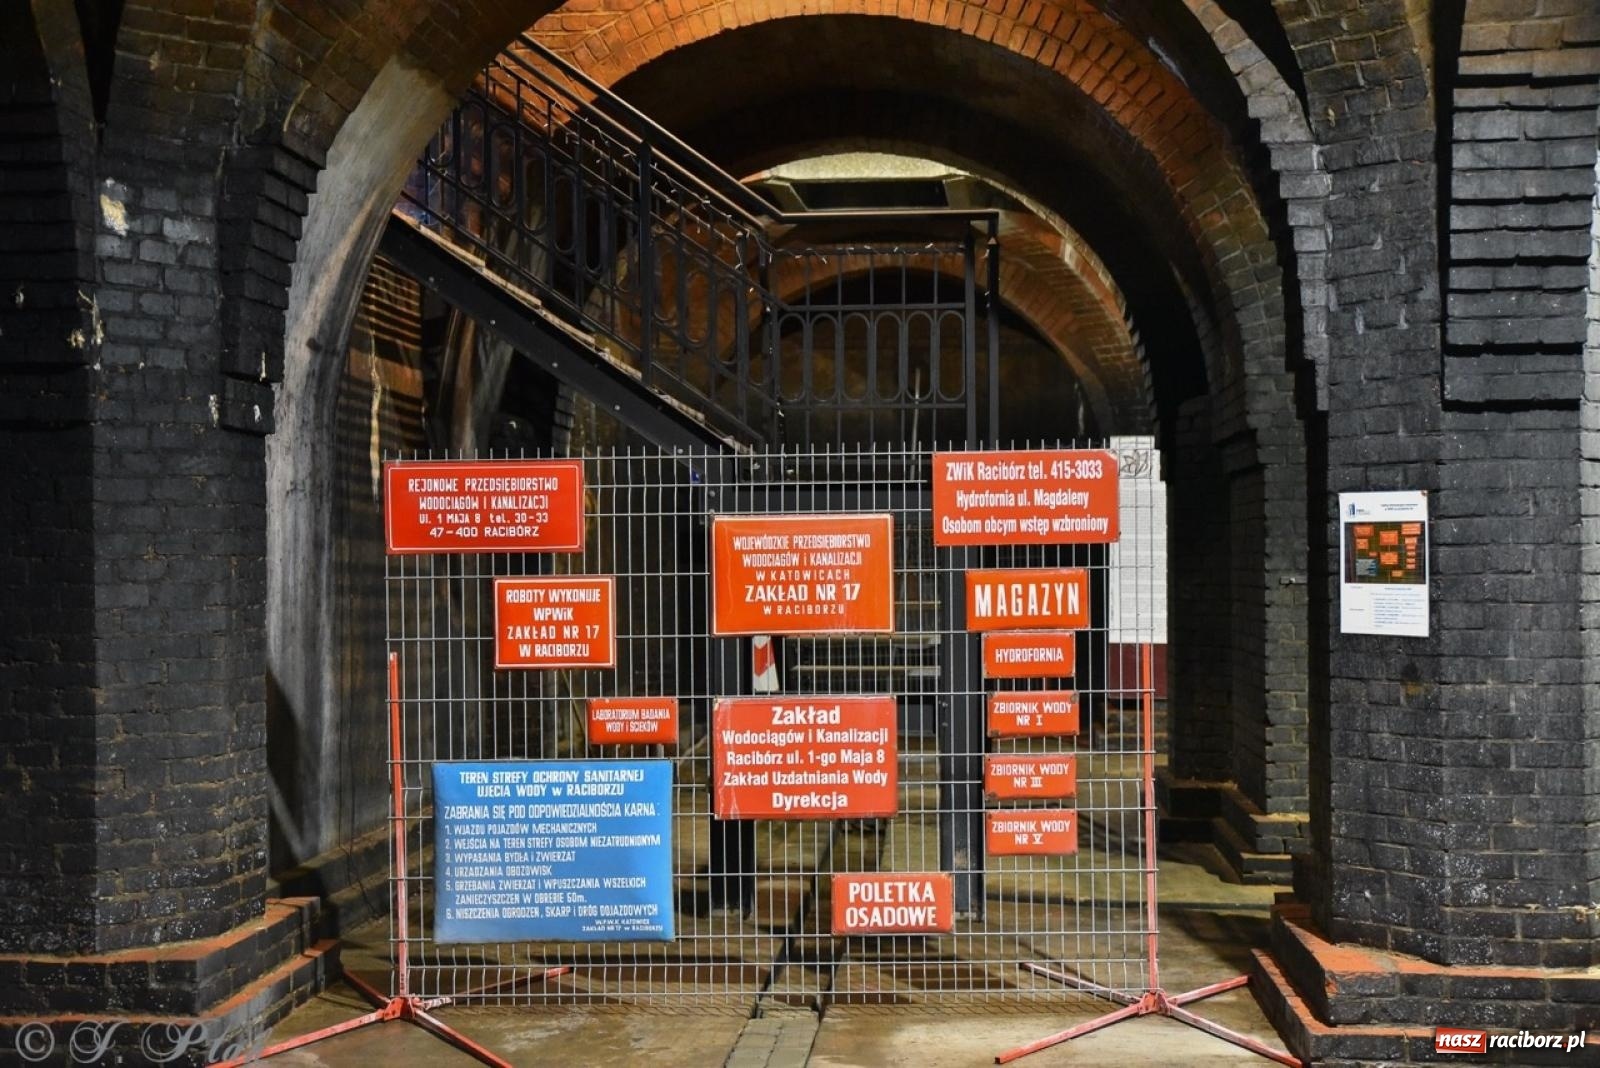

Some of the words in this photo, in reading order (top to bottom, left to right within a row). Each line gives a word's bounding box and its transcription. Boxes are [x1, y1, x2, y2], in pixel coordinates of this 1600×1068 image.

[946, 461, 974, 481] ZWiK
[978, 461, 1025, 480] Racibórz
[1028, 461, 1048, 479] tel.
[1050, 460, 1102, 479] 415-3033
[408, 478, 458, 492] REJONOWE
[465, 477, 558, 493] PRZEDSIĘBIORSTWO
[419, 495, 479, 511] WODOCIĄGÓW
[491, 495, 549, 510] KANALIZACJI
[956, 490, 1014, 511] Hydrofornia
[1018, 490, 1031, 506] ul.
[1033, 488, 1089, 509] Magdaleny
[437, 514, 442, 523] 1
[446, 514, 470, 523] MAJA
[475, 513, 481, 522] 8
[490, 513, 510, 523] tel.
[942, 516, 981, 534] Osobom
[984, 516, 1016, 536] obcym
[1020, 516, 1049, 536] wstęp
[1052, 515, 1109, 534] wzbroniony
[484, 525, 539, 537] RACIBÓRZ
[733, 534, 789, 550] WOJEWÓDZKIE
[793, 533, 871, 551] PRZEDSIĘBIORSTWO
[804, 553, 807, 565] i
[810, 551, 862, 565] KANALIZACJI
[756, 571, 765, 581] W
[771, 569, 850, 581] KATOWICACH
[506, 589, 545, 603] ROBOTY
[548, 588, 601, 603] WYKONUJE
[745, 584, 808, 602] ZAKŁAD
[816, 584, 836, 600] NR
[842, 583, 860, 600] 17
[974, 582, 1080, 617] MAGAZYN
[533, 607, 574, 621] WPWiK
[763, 605, 772, 615] W
[777, 604, 844, 615] RACIBORZU
[507, 625, 556, 640] ZAKŁAD
[563, 625, 579, 639] NR
[585, 625, 600, 639] 17
[519, 644, 531, 657] W
[535, 643, 590, 657] RACIBORZU
[995, 648, 1064, 663] HYDROFORNIA
[592, 708, 639, 720] LABORATORIUM
[641, 708, 670, 719] BADANIA
[771, 705, 841, 725] Zakład
[993, 702, 1039, 714] ZBIORNIK
[1043, 702, 1072, 713] WODY
[1016, 715, 1030, 726] NR
[722, 729, 804, 746] Wodociągów
[808, 729, 812, 743] i
[816, 728, 888, 745] Kanalizacji
[727, 750, 783, 765] Racibórz
[786, 750, 804, 764] ul.
[808, 750, 837, 766] 1-go
[840, 749, 873, 766] Maja
[876, 749, 885, 763] 8
[991, 764, 1035, 775] ZBIORNIK
[1040, 763, 1069, 775] WODY
[459, 771, 488, 785] TEREN
[492, 770, 529, 784] STREFY
[533, 770, 579, 783] OCHRONY
[584, 769, 644, 783] SANITARNEJ
[724, 772, 768, 786] Zakład
[772, 770, 849, 785] Uzdatniania
[852, 769, 888, 786] Wody
[1013, 777, 1027, 788] NR
[1030, 776, 1043, 788] III
[516, 784, 547, 796] WODY
[566, 783, 625, 796] RACIBORZU
[772, 792, 848, 811] Dyrekcja
[444, 805, 490, 820] ZABRANIA
[492, 805, 506, 821] SIĘ
[508, 805, 526, 818] POD
[454, 825, 486, 835] WJAZDU
[532, 822, 597, 834] MECHANICZNYCH
[992, 820, 1037, 833] ZBIORNIK
[1041, 820, 1071, 832] WODY
[489, 837, 501, 849] NA
[504, 837, 526, 849] TEREN
[527, 836, 553, 848] STREFY
[555, 836, 588, 848] OSOBOM
[590, 834, 661, 847] NIEZATRUDNIONYM
[1014, 834, 1028, 845] NR
[454, 851, 501, 863] WYPASANIA
[504, 851, 529, 863] BYDŁA
[506, 864, 552, 876] OBOZOWISK
[544, 878, 600, 890] WPUSZCZANIA
[603, 876, 647, 888] WSZELKICH
[522, 893, 532, 904] W
[849, 882, 935, 903] POLETKA
[455, 908, 500, 920] NISZCZENIA
[545, 906, 571, 918] SKARP
[599, 903, 659, 916] DOJAZDOWYCH
[845, 906, 937, 928] OSADOWE
